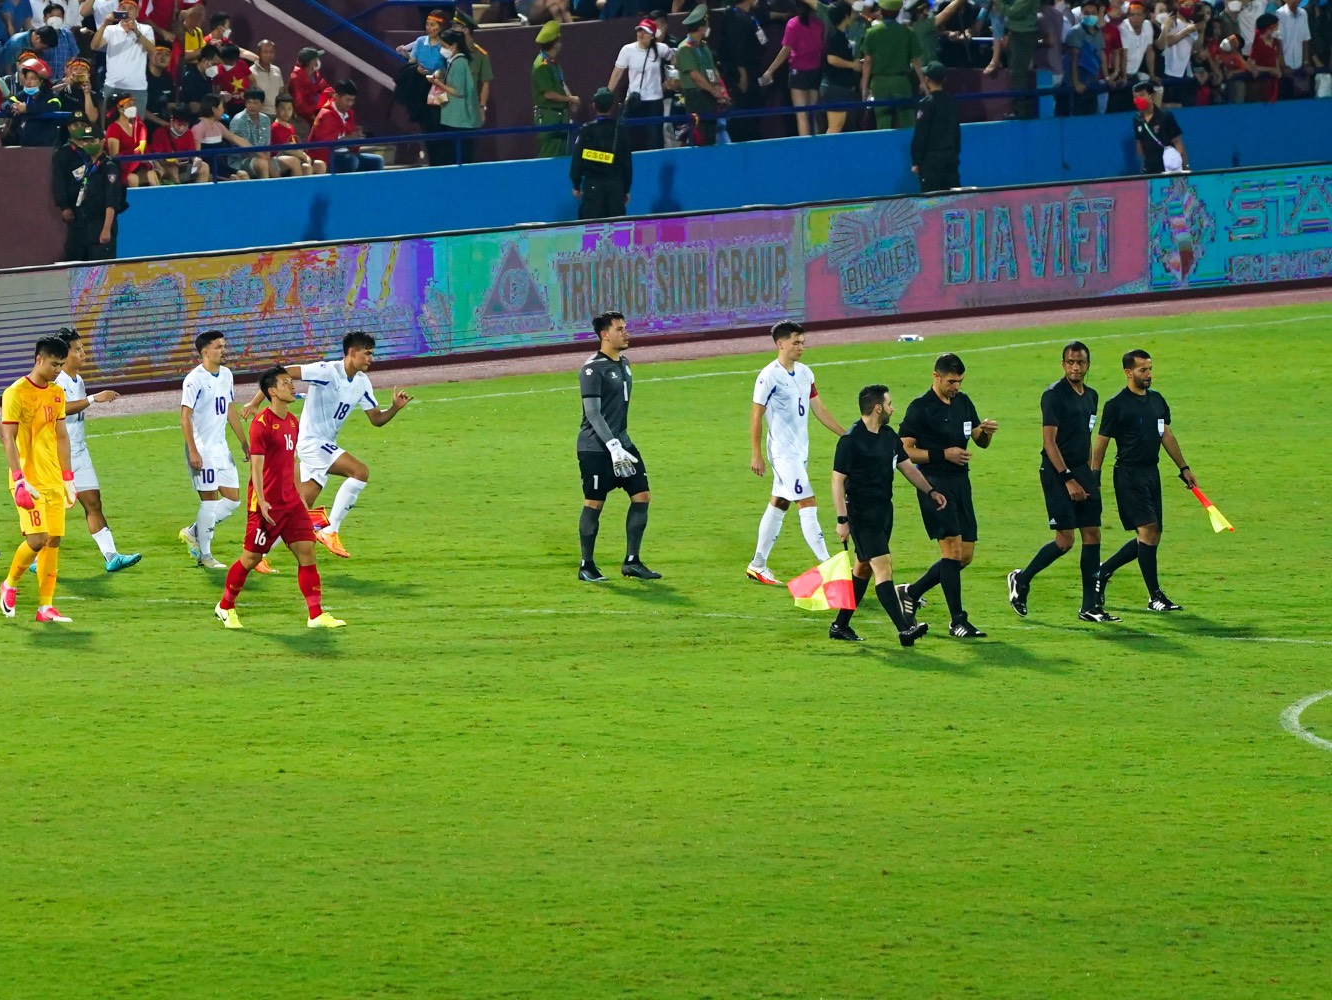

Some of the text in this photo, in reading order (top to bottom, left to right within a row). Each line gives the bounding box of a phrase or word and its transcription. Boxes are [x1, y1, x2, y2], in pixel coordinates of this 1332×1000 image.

[943, 186, 1115, 288] BIA VIỆT
[655, 250, 709, 316] SINH
[718, 245, 788, 305] GROUP
[623, 381, 629, 401] 1
[43, 405, 54, 422] 18
[215, 396, 226, 415] 10
[333, 401, 351, 420] 18
[798, 397, 806, 417] 6
[284, 433, 294, 451] 16
[201, 468, 215, 484] 10
[593, 475, 599, 490] 1
[794, 478, 803, 495] 6
[28, 510, 42, 527] 18
[254, 528, 267, 546] 16
